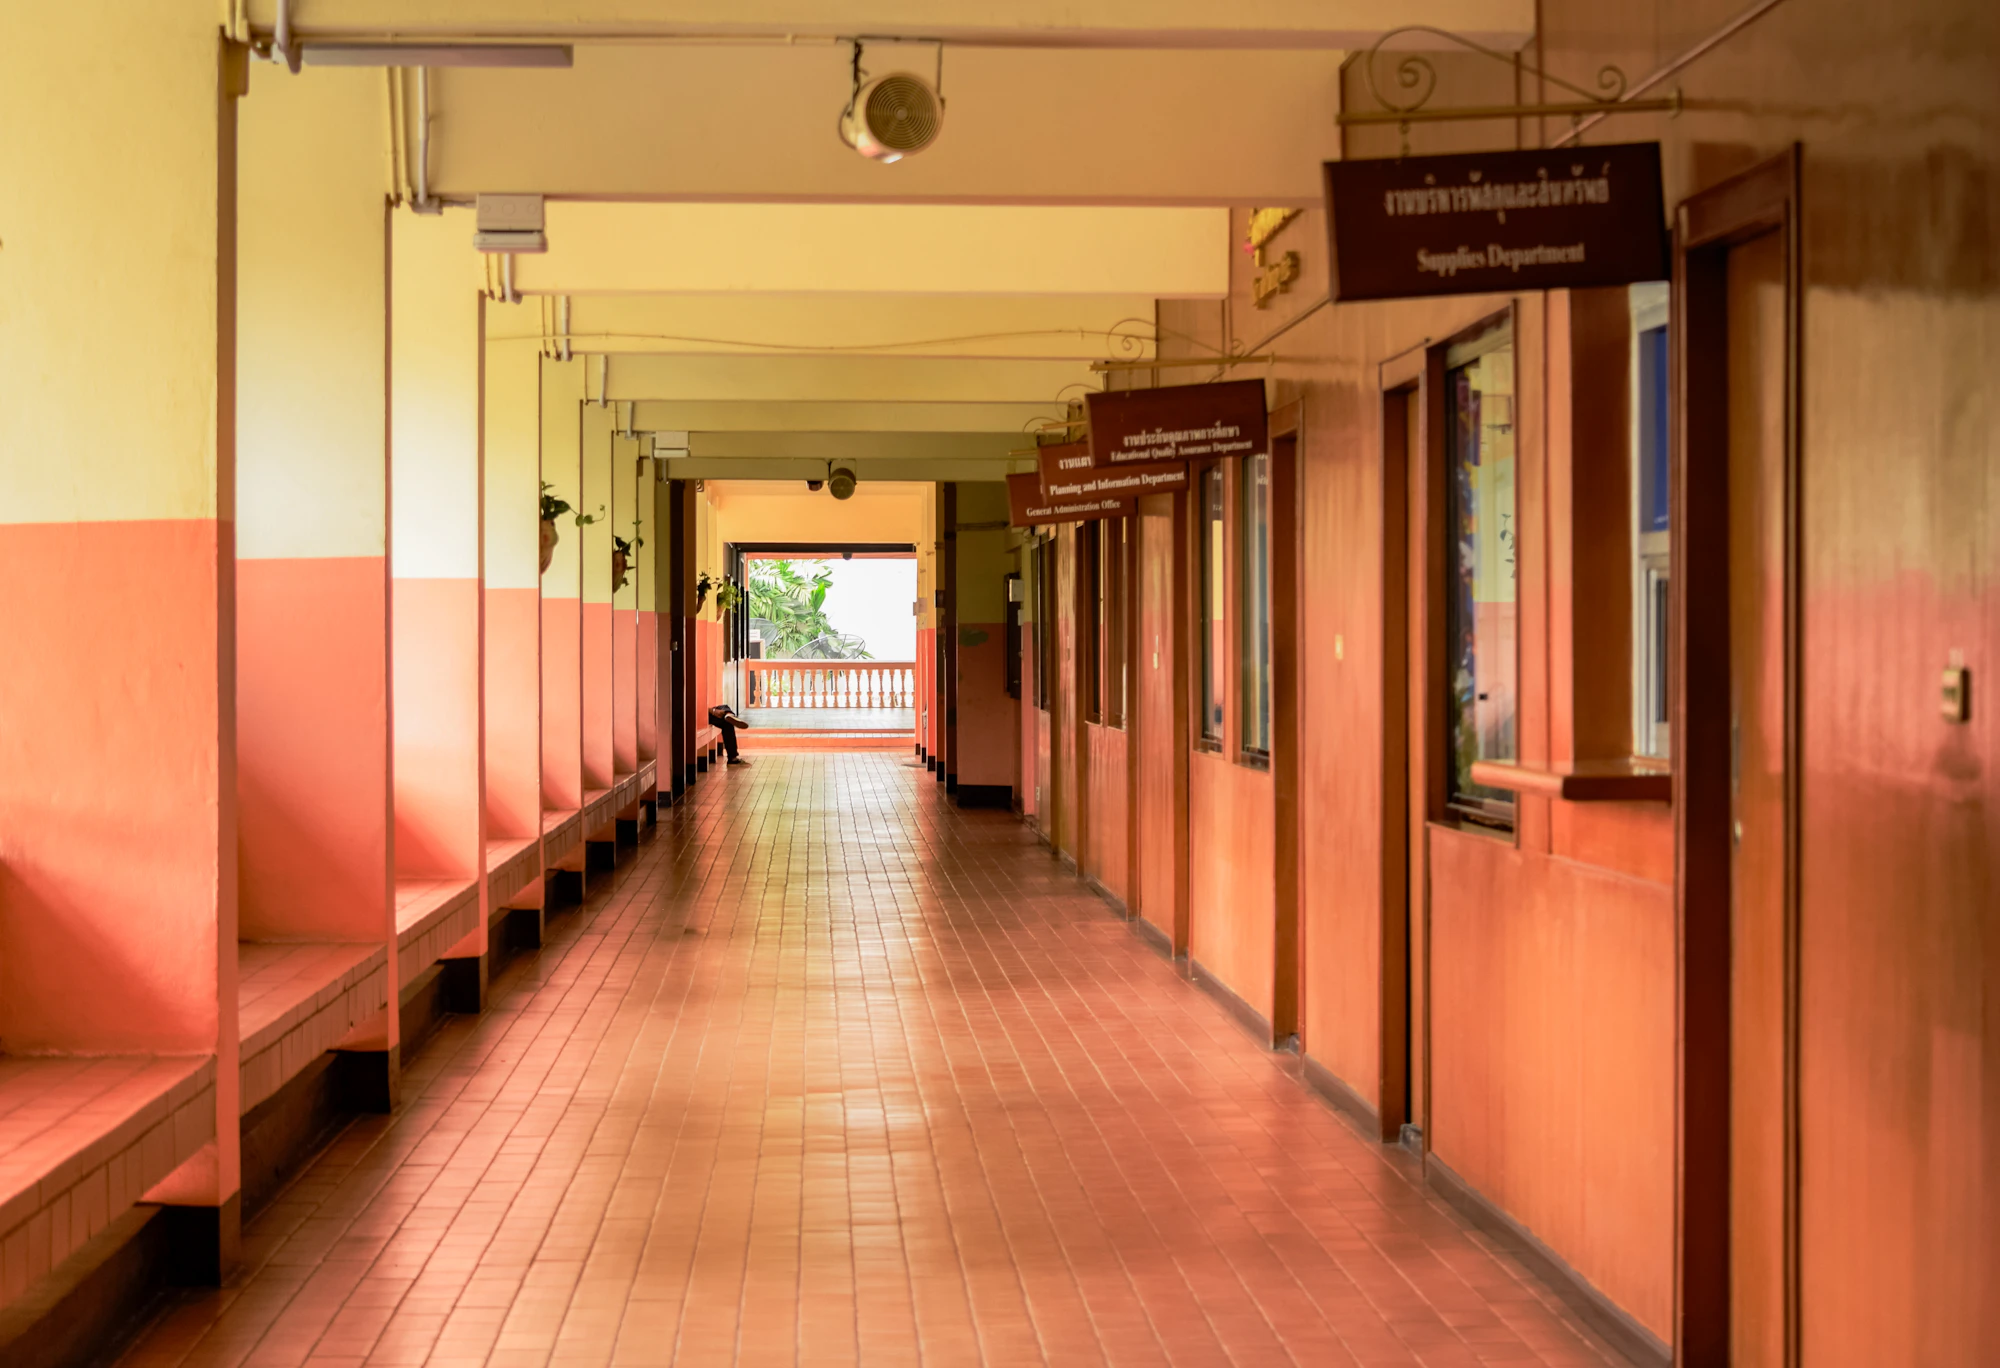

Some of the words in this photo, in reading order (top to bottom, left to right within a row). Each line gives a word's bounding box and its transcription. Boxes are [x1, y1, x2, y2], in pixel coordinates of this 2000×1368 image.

[1417, 245, 1486, 277] Supplies
[1487, 242, 1586, 272] Department
[1111, 449, 1150, 462] Educational
[1151, 447, 1176, 460] Quality
[1178, 444, 1212, 456] Assurance
[1213, 440, 1253, 454] Department
[1049, 483, 1082, 496] Planning
[1083, 480, 1096, 491] and
[1097, 475, 1140, 490] Information
[1141, 471, 1185, 486] Department
[1026, 506, 1052, 517] General
[1053, 502, 1100, 514] Administration
[1101, 499, 1121, 510] Office
